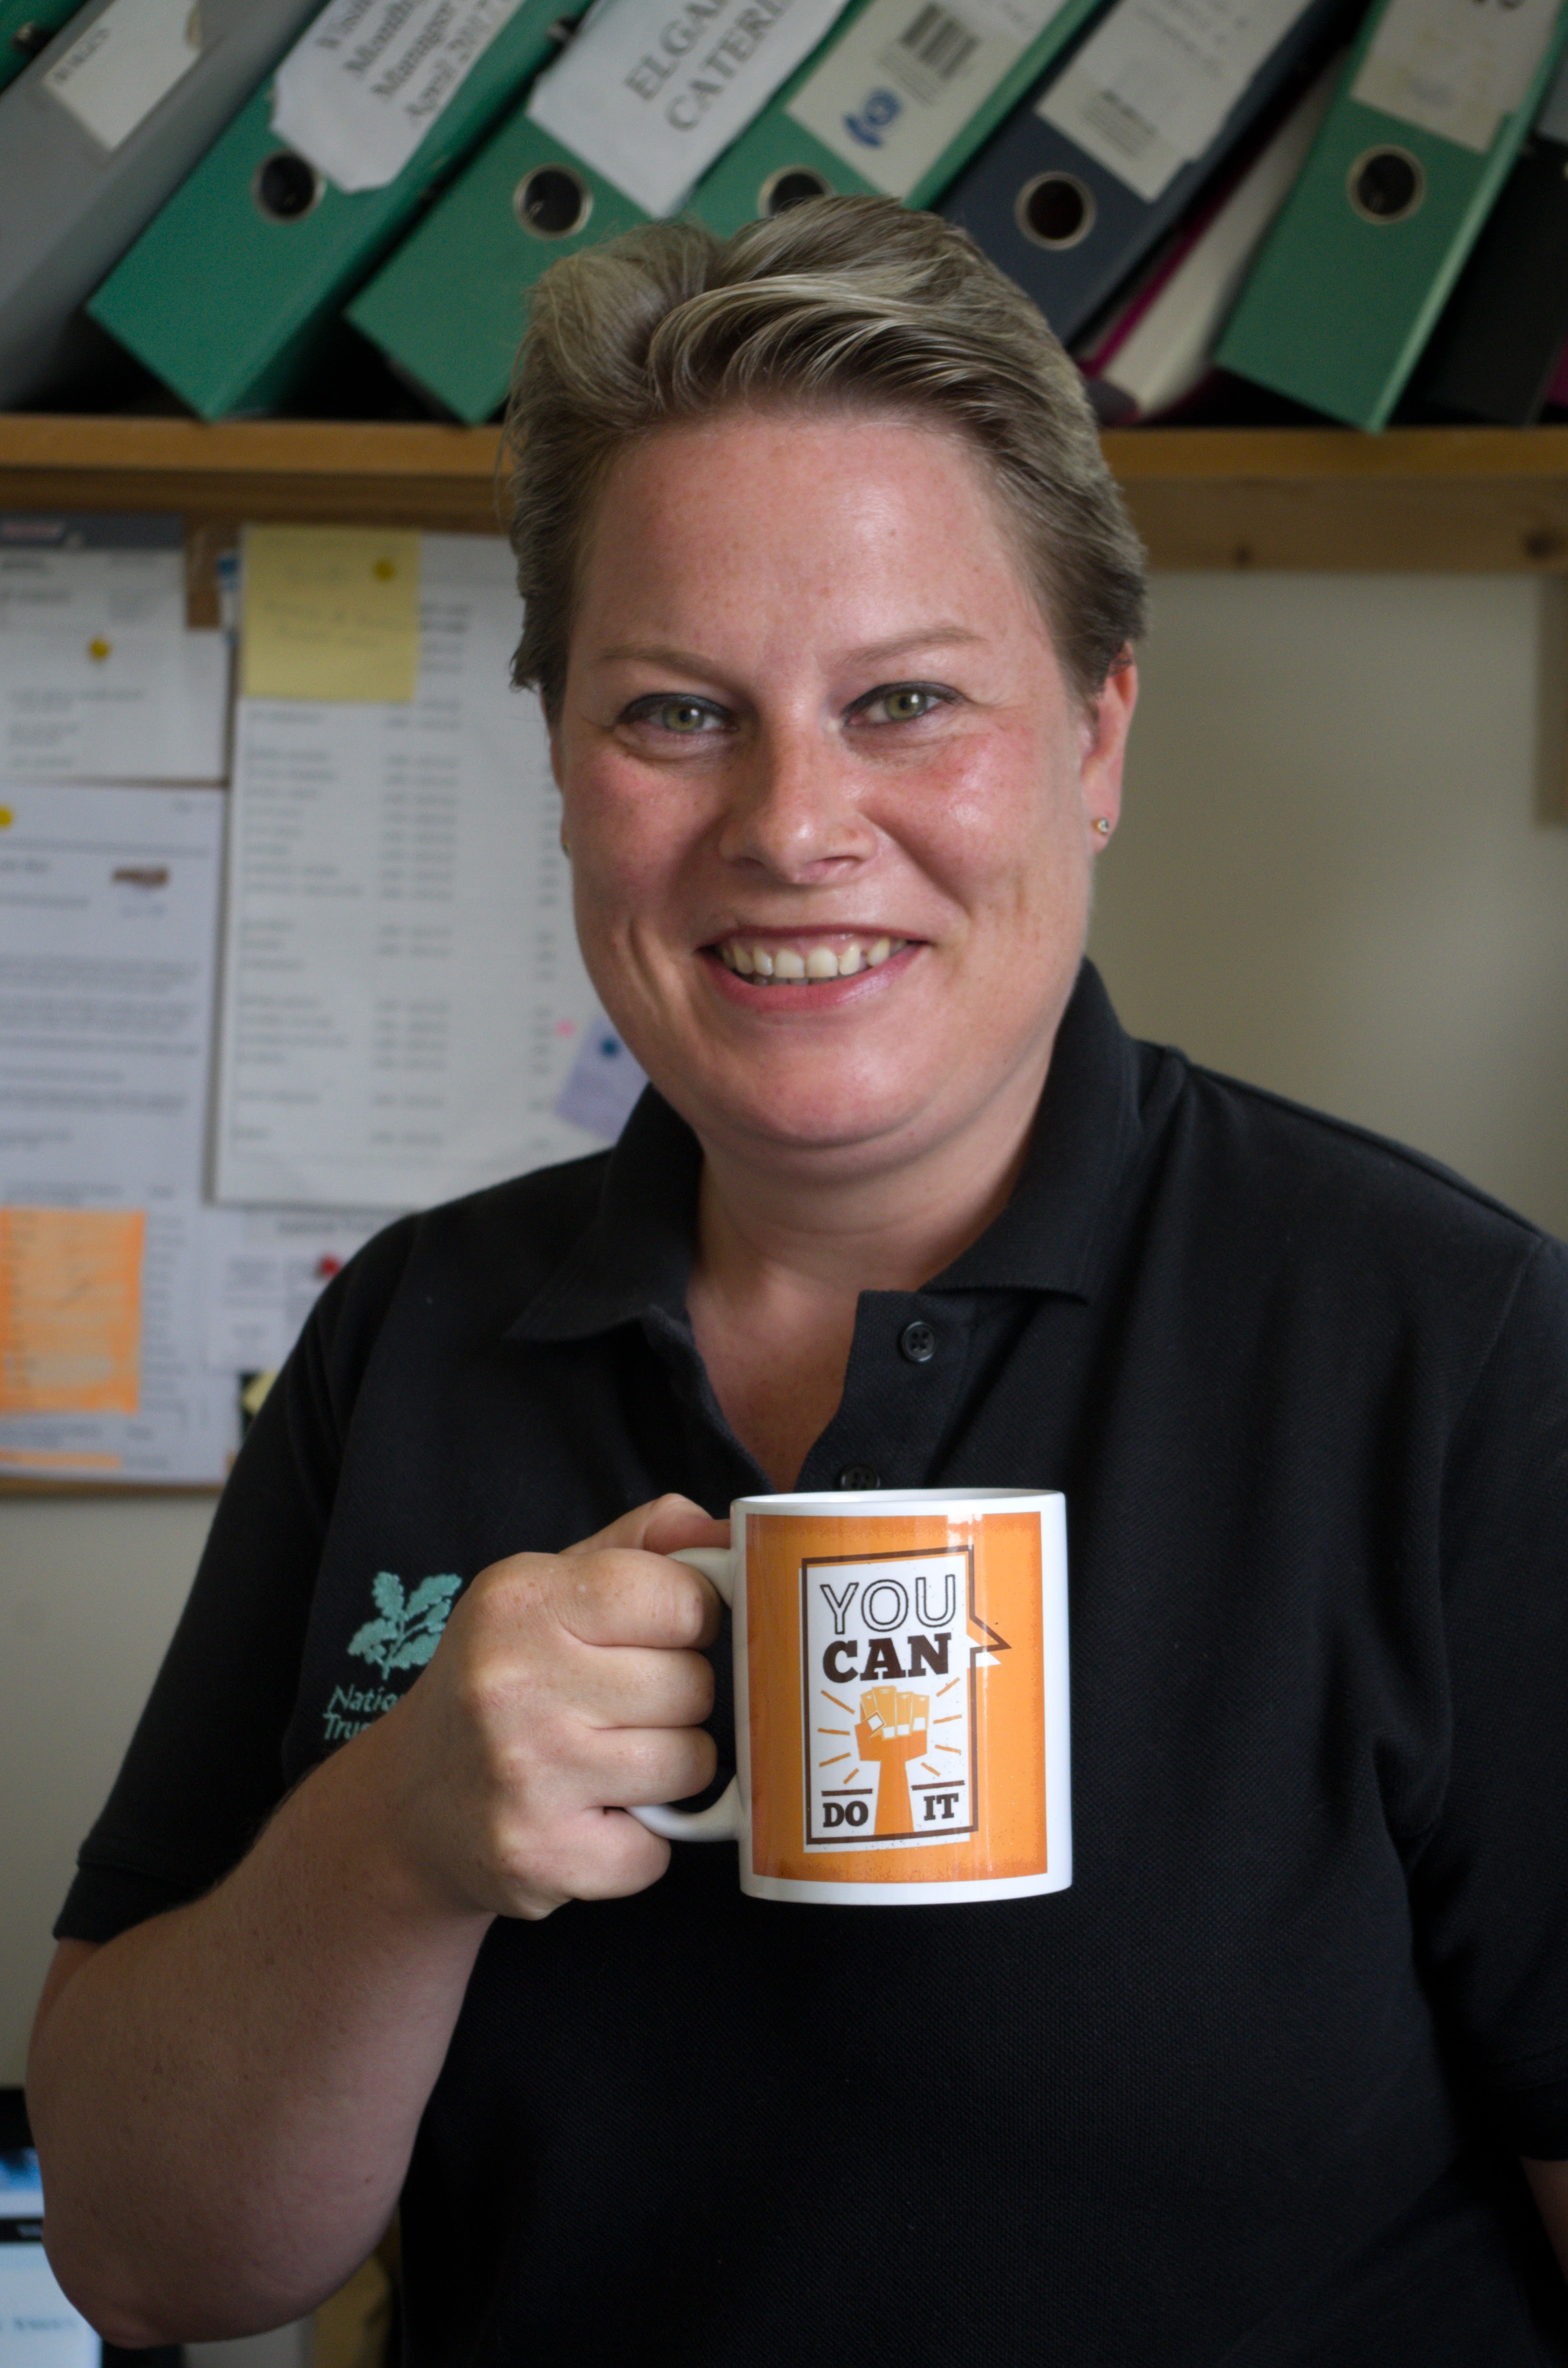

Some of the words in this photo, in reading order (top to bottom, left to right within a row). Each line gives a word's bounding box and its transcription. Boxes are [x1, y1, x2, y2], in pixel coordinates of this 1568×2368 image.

[820, 1574, 956, 1635] YOU
[822, 1632, 952, 1683] CAN
[327, 1683, 404, 1713] Natio
[823, 1800, 869, 1827] DO
[923, 1793, 959, 1821] IT
